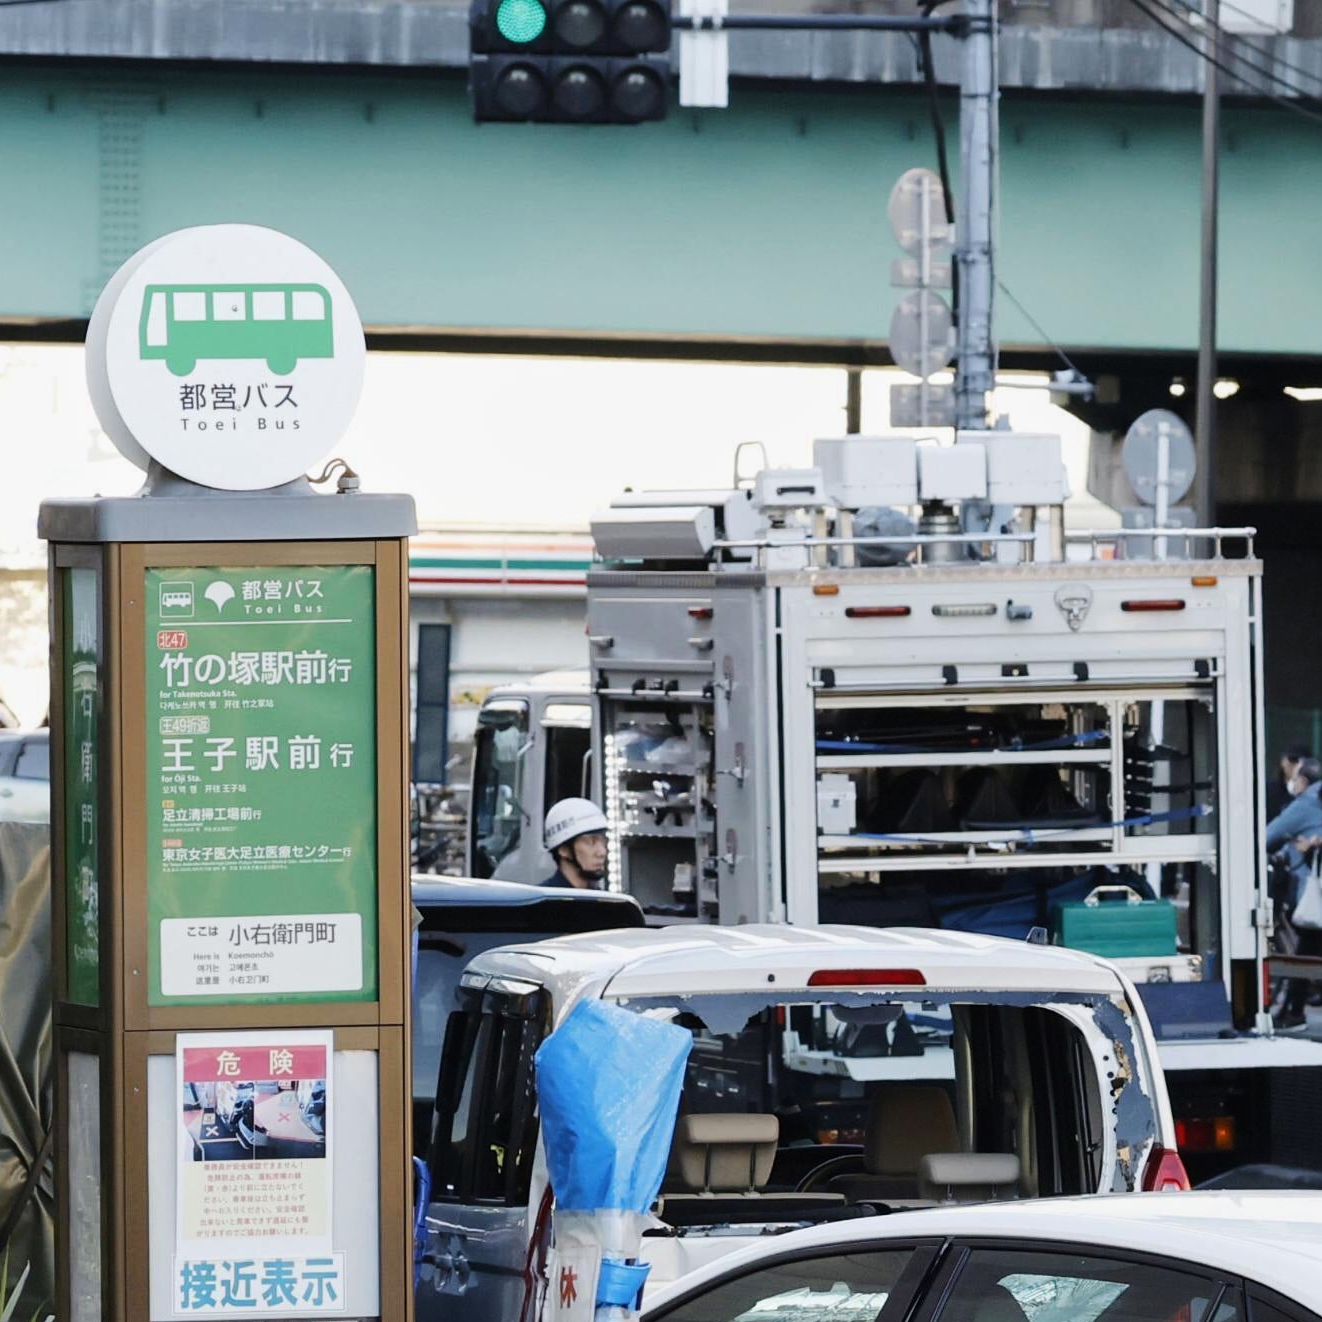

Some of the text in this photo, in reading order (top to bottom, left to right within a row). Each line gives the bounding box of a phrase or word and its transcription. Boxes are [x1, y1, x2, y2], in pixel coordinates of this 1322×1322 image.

[179, 382, 300, 412] 都営バス
[180, 415, 303, 432] Toei Bus
[241, 579, 324, 601] 都営バス
[244, 603, 324, 614] Toei Bus
[159, 632, 186, 648] 北47
[159, 650, 353, 688] 竹の塚駅前行
[159, 690, 172, 699] for
[162, 735, 354, 772] 王子駅前行
[161, 774, 173, 783] for
[162, 807, 261, 822] 足立清掃工場前行
[162, 845, 352, 863] 東京女子医大足立医療センター行
[187, 921, 337, 947] ここは 小右衛門町
[216, 1050, 294, 1077] 危険
[180, 1257, 338, 1310] 接近表示
